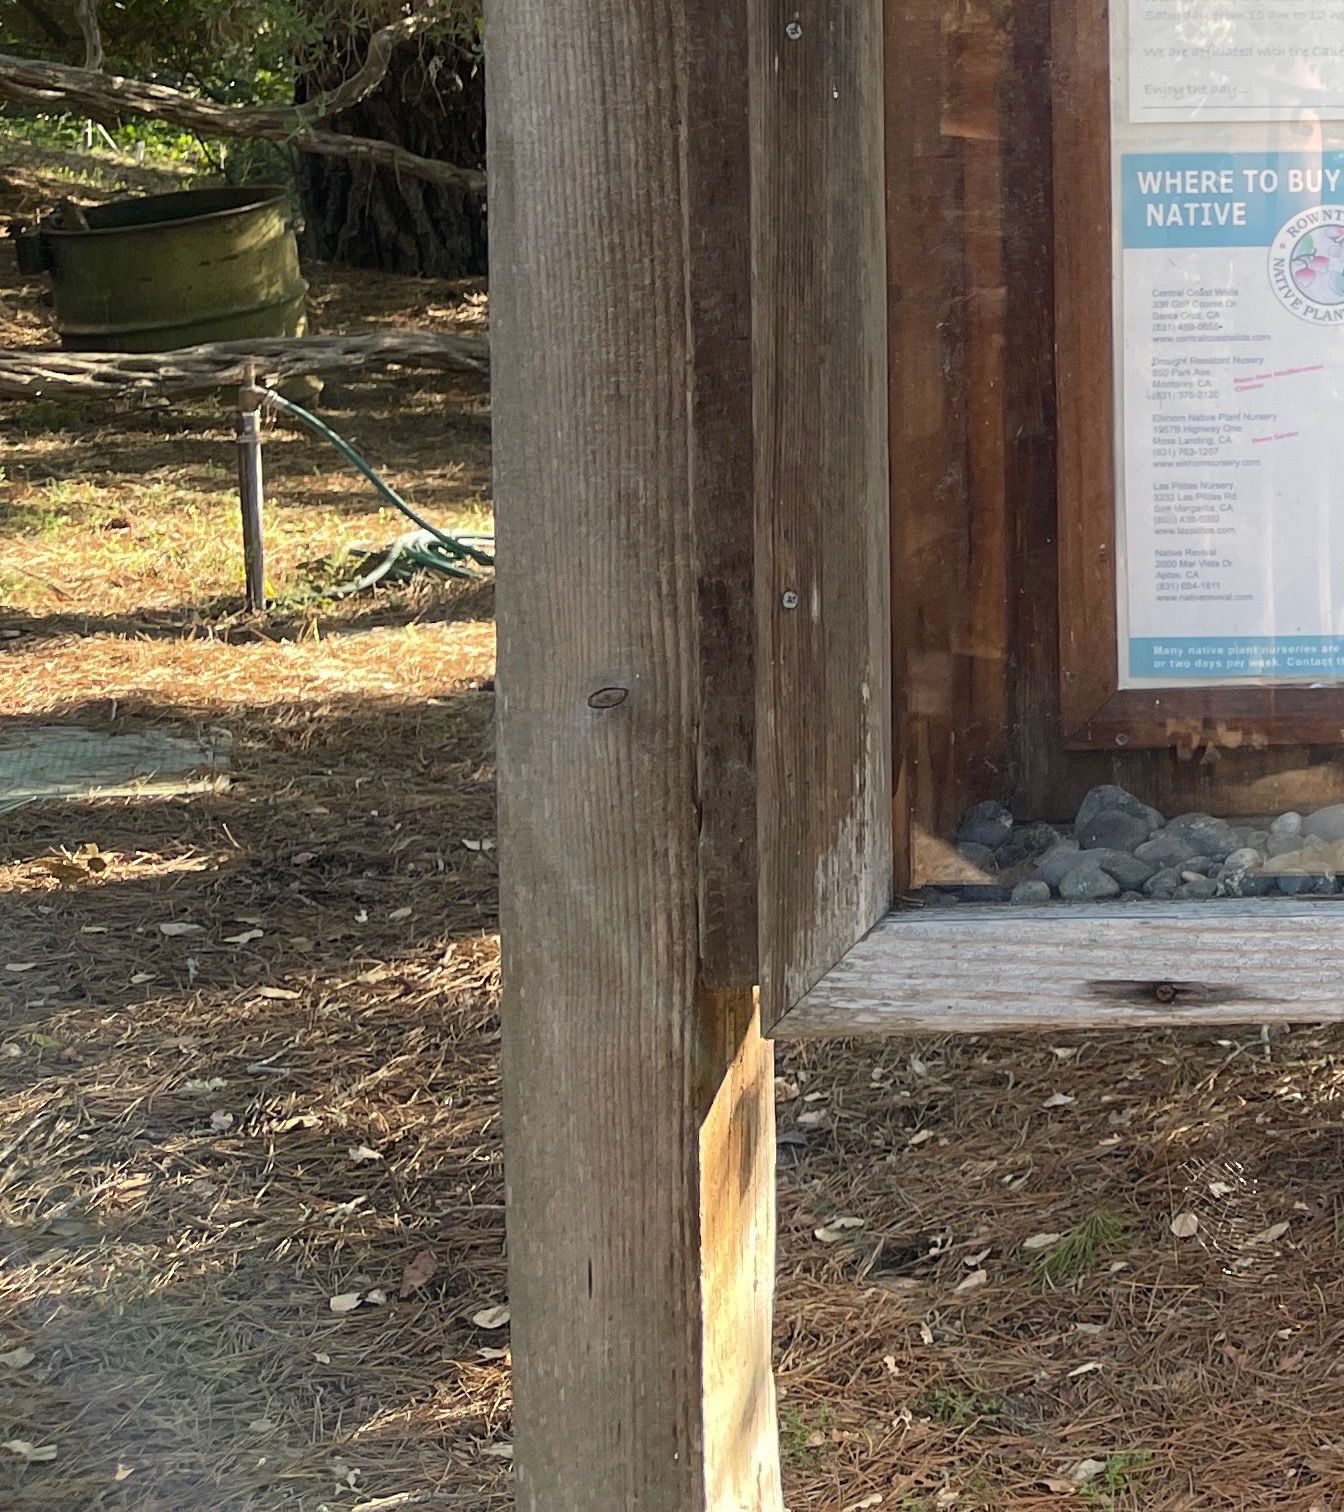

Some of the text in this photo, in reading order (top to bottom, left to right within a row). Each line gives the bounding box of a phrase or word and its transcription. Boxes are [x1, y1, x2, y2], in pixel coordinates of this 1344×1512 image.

[1138, 170, 1234, 194] WHERE
[1243, 170, 1278, 193] TO
[1288, 169, 1340, 193] BUY
[1146, 202, 1246, 227] NATIVE
[1273, 257, 1302, 312] NATIVE
[1153, 646, 1183, 657] Many
[1188, 646, 1224, 655] native
[1228, 646, 1258, 655] plant
[1261, 645, 1317, 655] nurseries
[1322, 645, 1340, 653] are
[1153, 660, 1165, 668] or
[1170, 660, 1191, 668] two
[1195, 659, 1222, 669] days
[1227, 660, 1245, 669] per
[1287, 657, 1332, 666] Contact
